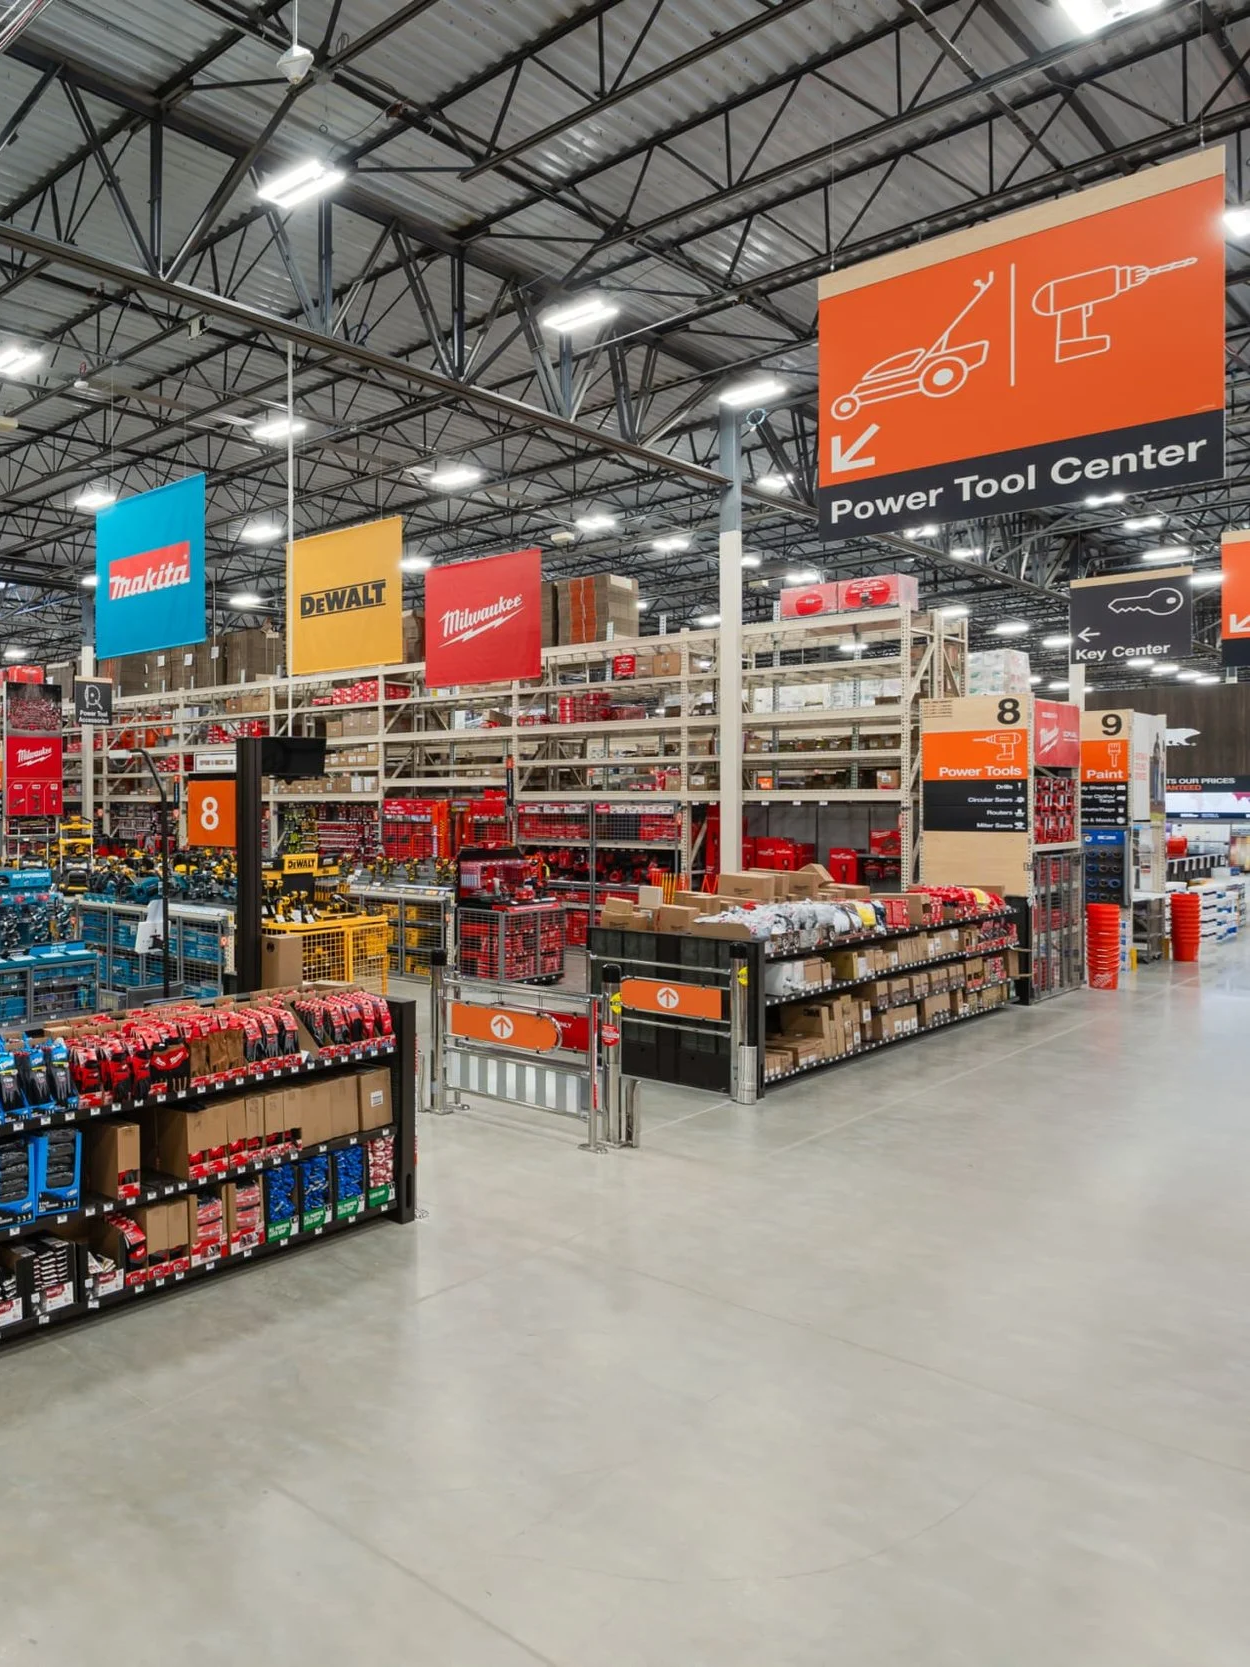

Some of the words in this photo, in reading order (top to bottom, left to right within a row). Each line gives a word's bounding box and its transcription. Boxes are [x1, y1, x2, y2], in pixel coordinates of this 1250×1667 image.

[831, 486, 944, 524] Power
[954, 464, 1036, 501] Tool
[1050, 438, 1208, 485] Center
[439, 594, 523, 638] Milwaukee
[1076, 648, 1106, 661] Key
[1111, 642, 1171, 658] Center
[997, 698, 1021, 725] 8
[1101, 713, 1122, 736] 9
[16, 747, 52, 762] Milwaukee
[939, 766, 982, 777] Power
[985, 765, 1022, 776] Tools
[1086, 769, 1124, 780] Paint
[200, 797, 219, 830] 8
